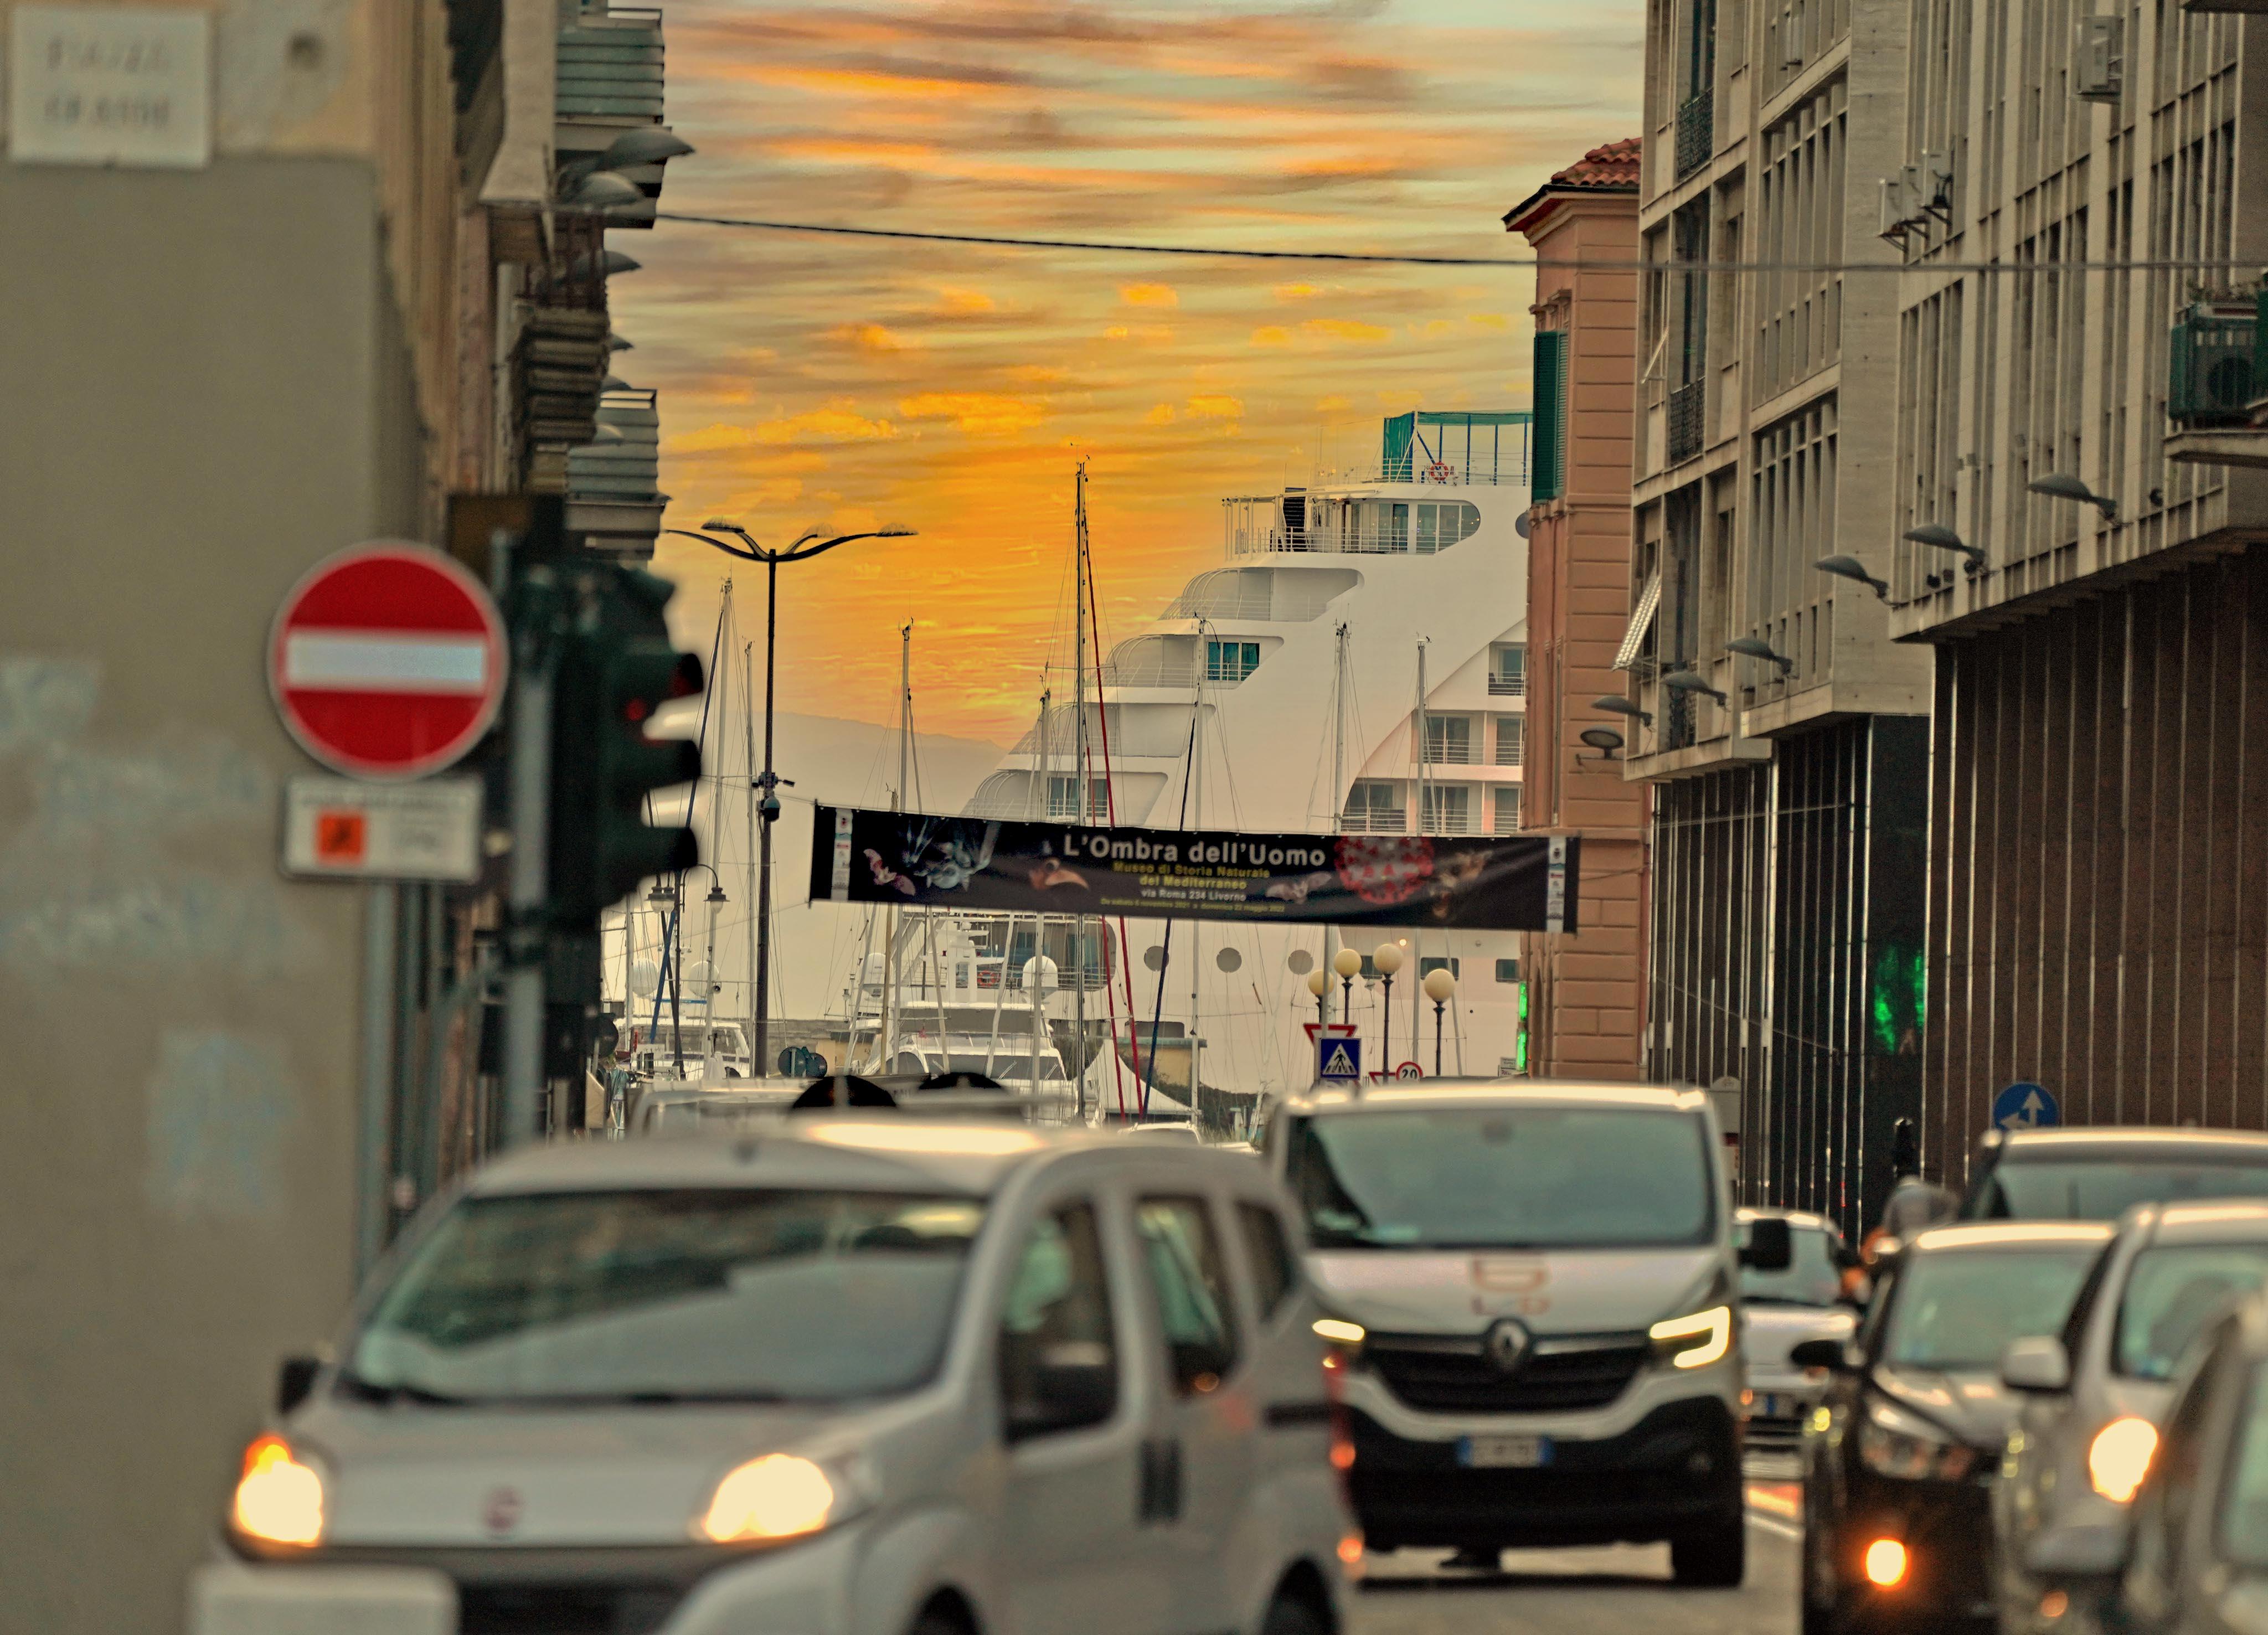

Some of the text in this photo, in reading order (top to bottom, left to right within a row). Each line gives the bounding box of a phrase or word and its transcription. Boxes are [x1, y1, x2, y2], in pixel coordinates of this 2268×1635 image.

[1064, 834, 1326, 867] L'Ombra dell'Uomo
[1112, 860, 1270, 878] Museo di Storia Naturale
[1139, 874, 1246, 889] del Mediterraneo
[1141, 889, 1246, 901] via Roma 234 Livorno
[1401, 1069, 1418, 1080] 20
